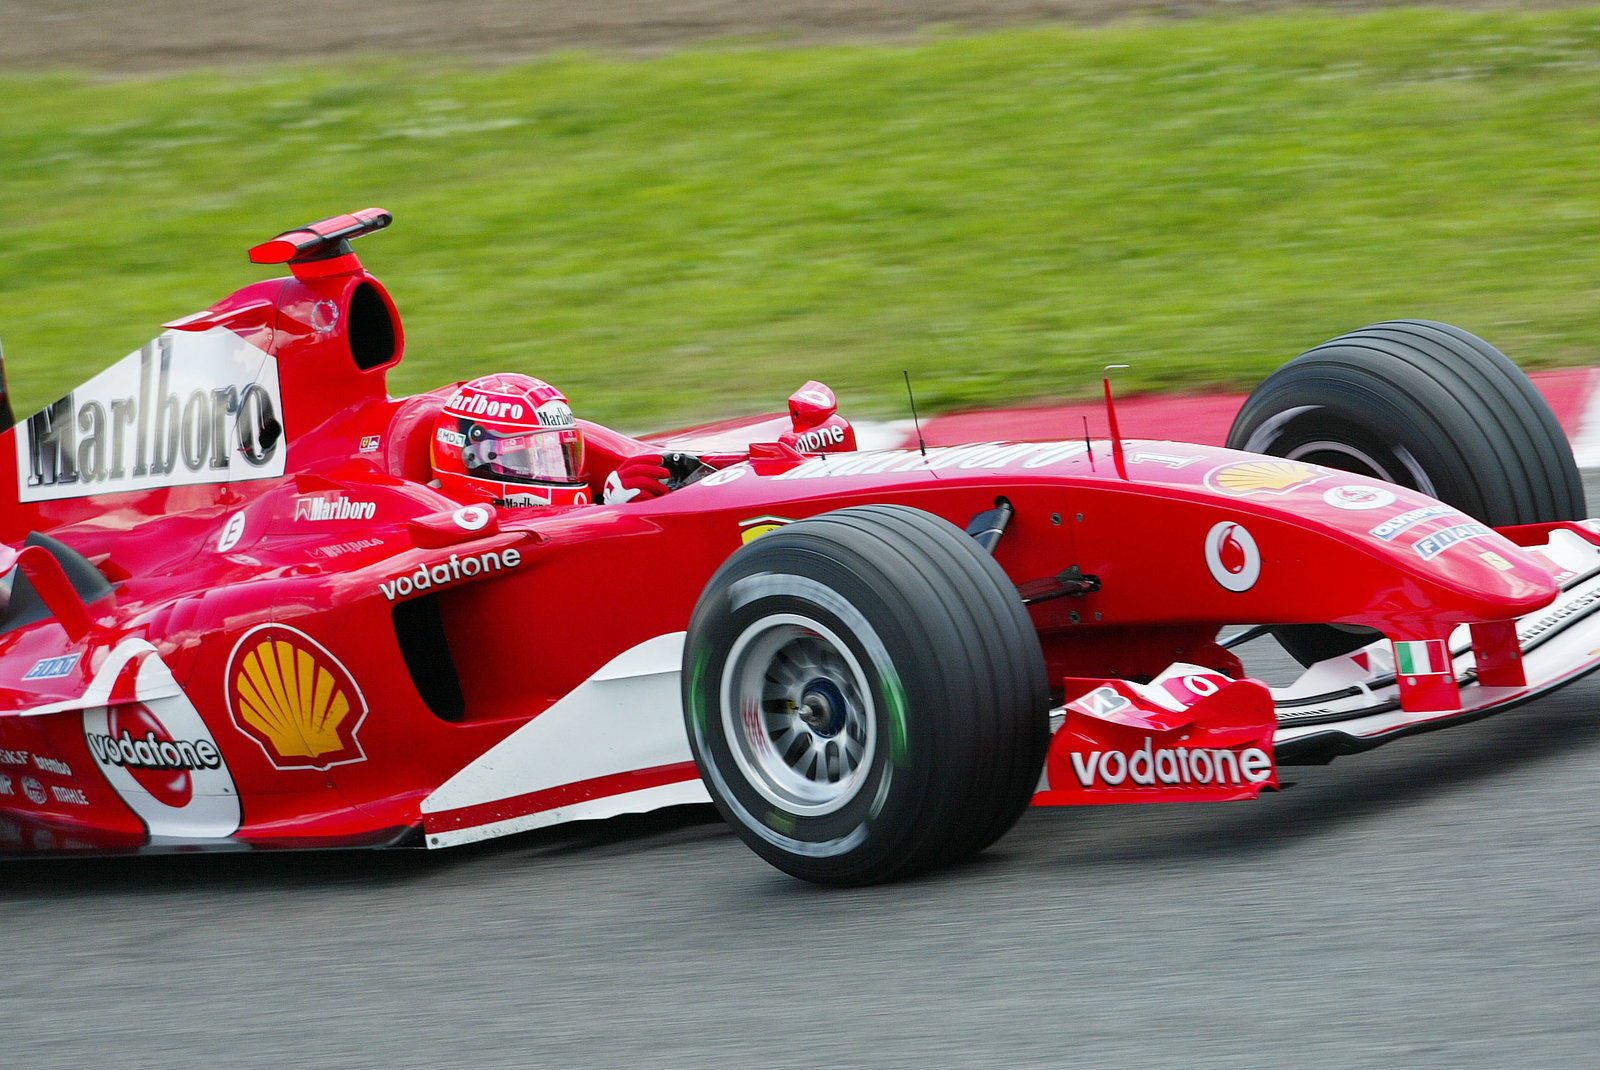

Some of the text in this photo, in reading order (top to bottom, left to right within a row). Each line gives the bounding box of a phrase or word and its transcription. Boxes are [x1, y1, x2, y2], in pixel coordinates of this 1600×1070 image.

[28, 335, 279, 488] Marlboro
[310, 497, 376, 521] Marlboro
[1418, 524, 1489, 555] FIAT
[378, 548, 521, 600] vodafone
[30, 655, 78, 678] FIAT
[32, 753, 72, 776] brembo
[88, 729, 221, 770] vodafone
[1071, 737, 1272, 787] vodafone
[51, 786, 90, 805] MAHLE
